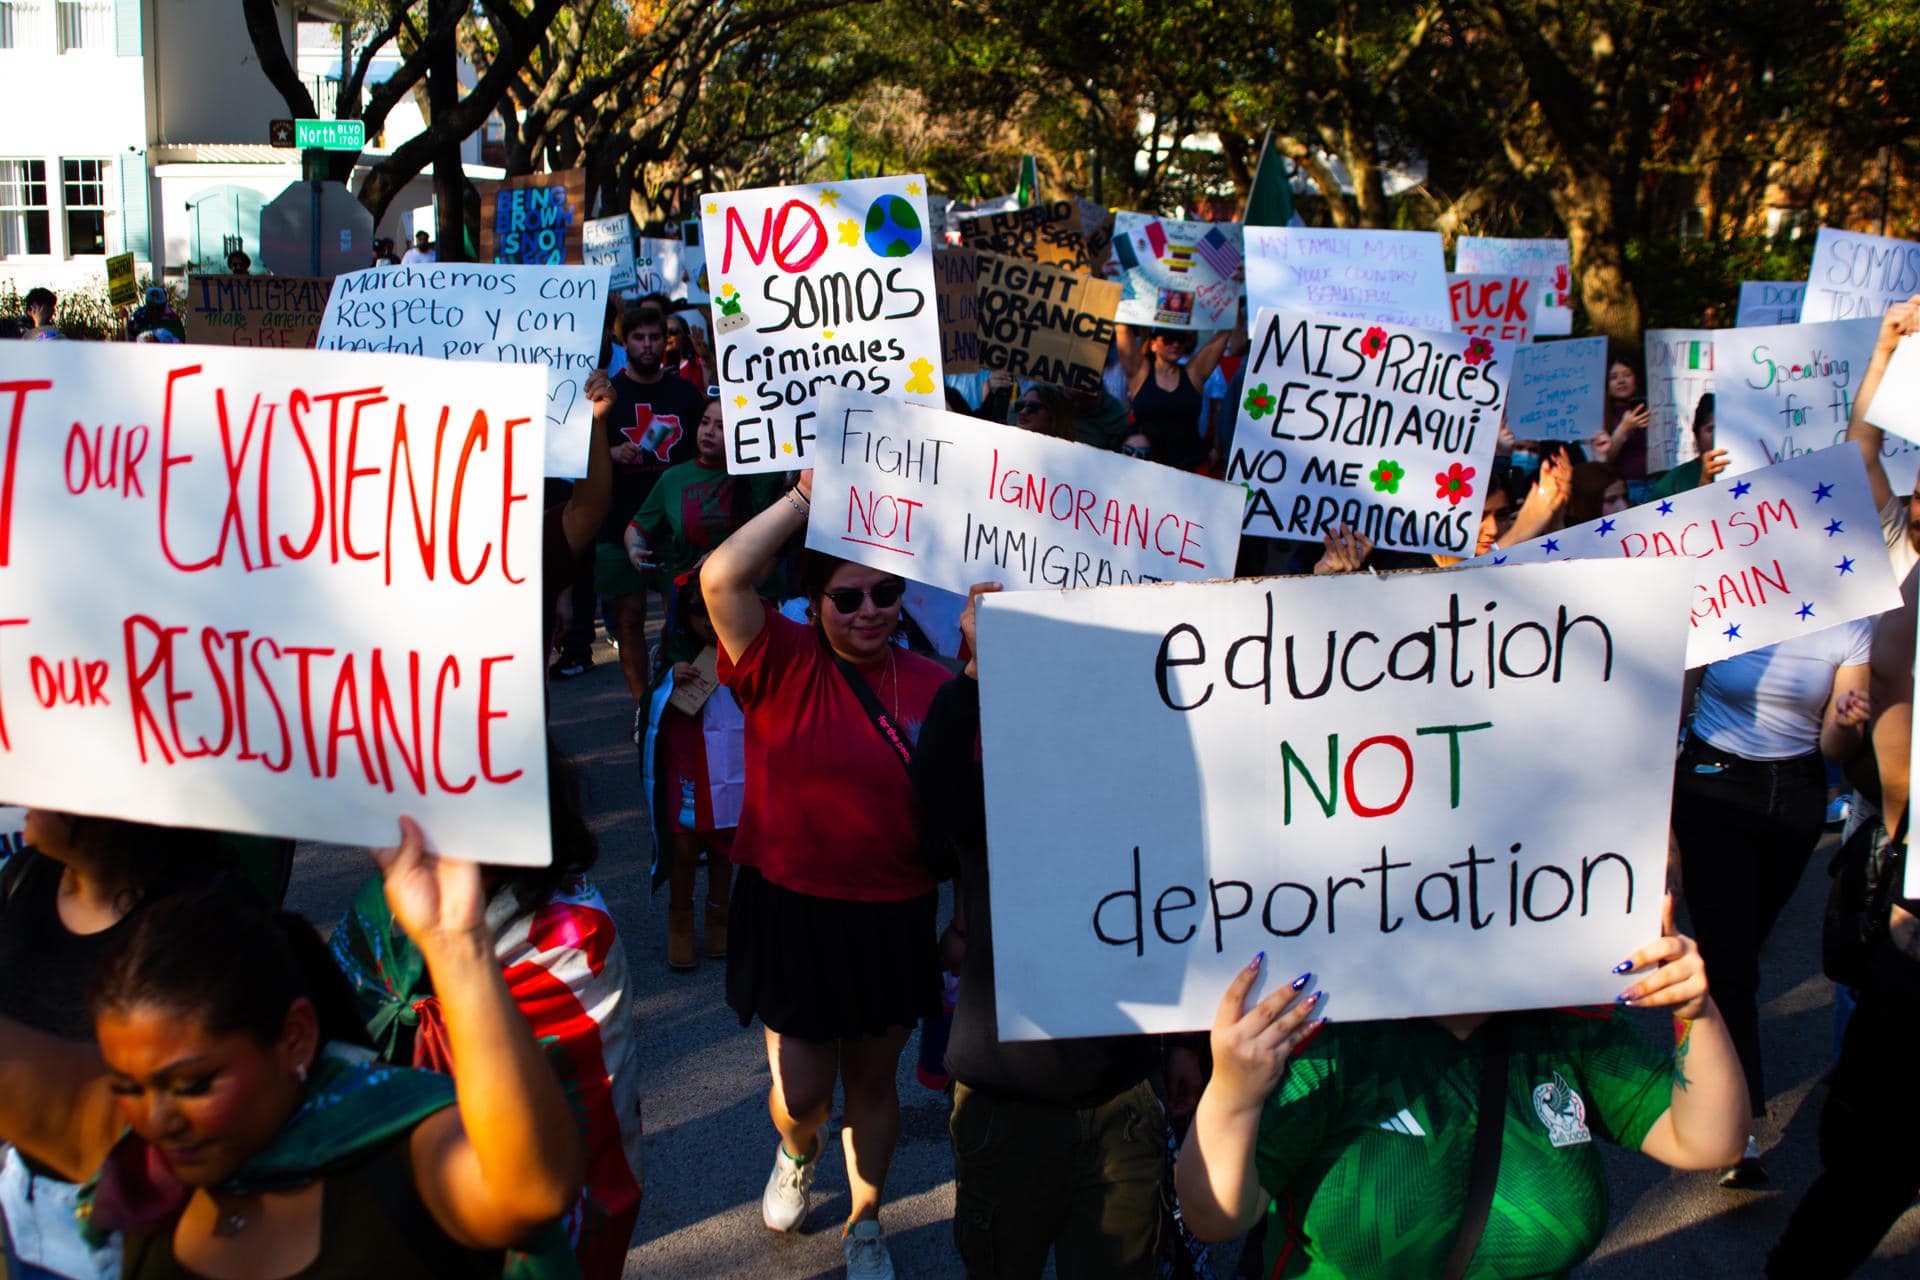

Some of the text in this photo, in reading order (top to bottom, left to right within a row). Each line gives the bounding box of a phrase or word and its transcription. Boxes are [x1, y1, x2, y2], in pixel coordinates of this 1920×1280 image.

[299, 125, 336, 144] North
[337, 125, 361, 134] BLVD
[339, 136, 360, 145] 1700
[496, 204, 575, 233] BROWN
[497, 185, 567, 211] BEING
[592, 250, 620, 266] NOT
[721, 199, 829, 274] NO
[1259, 235, 1425, 263] MY FAMILY MADE
[340, 266, 597, 301] Marchemos con
[976, 255, 1078, 303] FIGHT
[1344, 264, 1417, 287] COUNTRY
[1827, 238, 1918, 294] SOMOS
[1449, 277, 1530, 323] FUCK
[485, 308, 501, 341] y
[517, 308, 575, 332] con
[977, 310, 1038, 348] NOT
[443, 339, 486, 360] por
[722, 338, 905, 383] Criminales
[1252, 314, 1366, 383] MIS
[1746, 344, 1850, 397] Speaking
[1779, 393, 1813, 429] for
[64, 421, 150, 499] OUR
[158, 364, 532, 587] EXISTENCE
[840, 408, 1205, 569] FIGHT IGNORANCE
[1227, 448, 1363, 487] NO ME
[847, 485, 923, 543] NOT
[1689, 559, 1792, 629] GAIN
[1153, 591, 1615, 711] education
[30, 654, 111, 709] OUR
[123, 613, 524, 796] RESISTANCE
[1279, 721, 1494, 826] NOT
[1092, 843, 1635, 957] deportation
